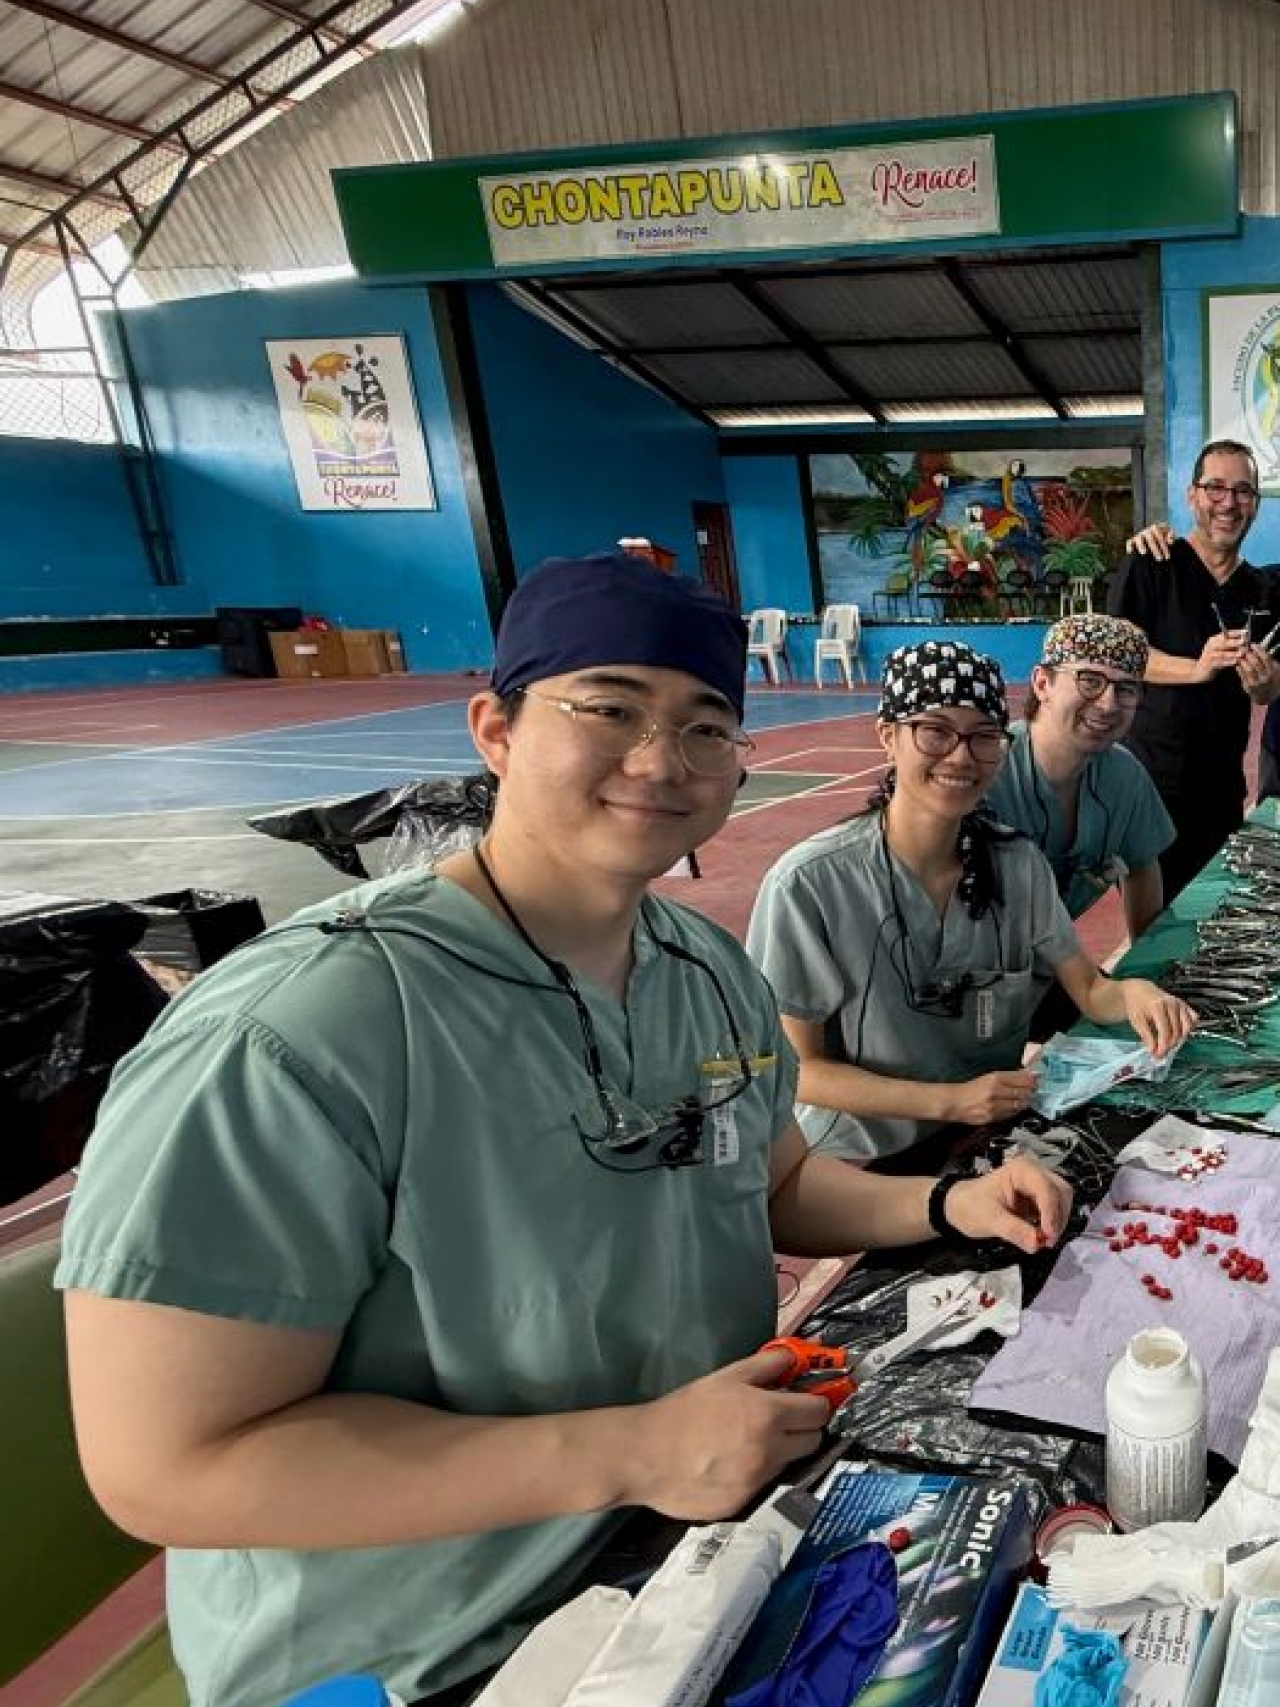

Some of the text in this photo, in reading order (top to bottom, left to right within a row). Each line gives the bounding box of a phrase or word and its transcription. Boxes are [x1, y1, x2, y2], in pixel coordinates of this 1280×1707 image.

[491, 160, 845, 229] CHONTAPUNTA
[872, 159, 976, 208] Renace!
[959, 1487, 1013, 1570] Sonic
